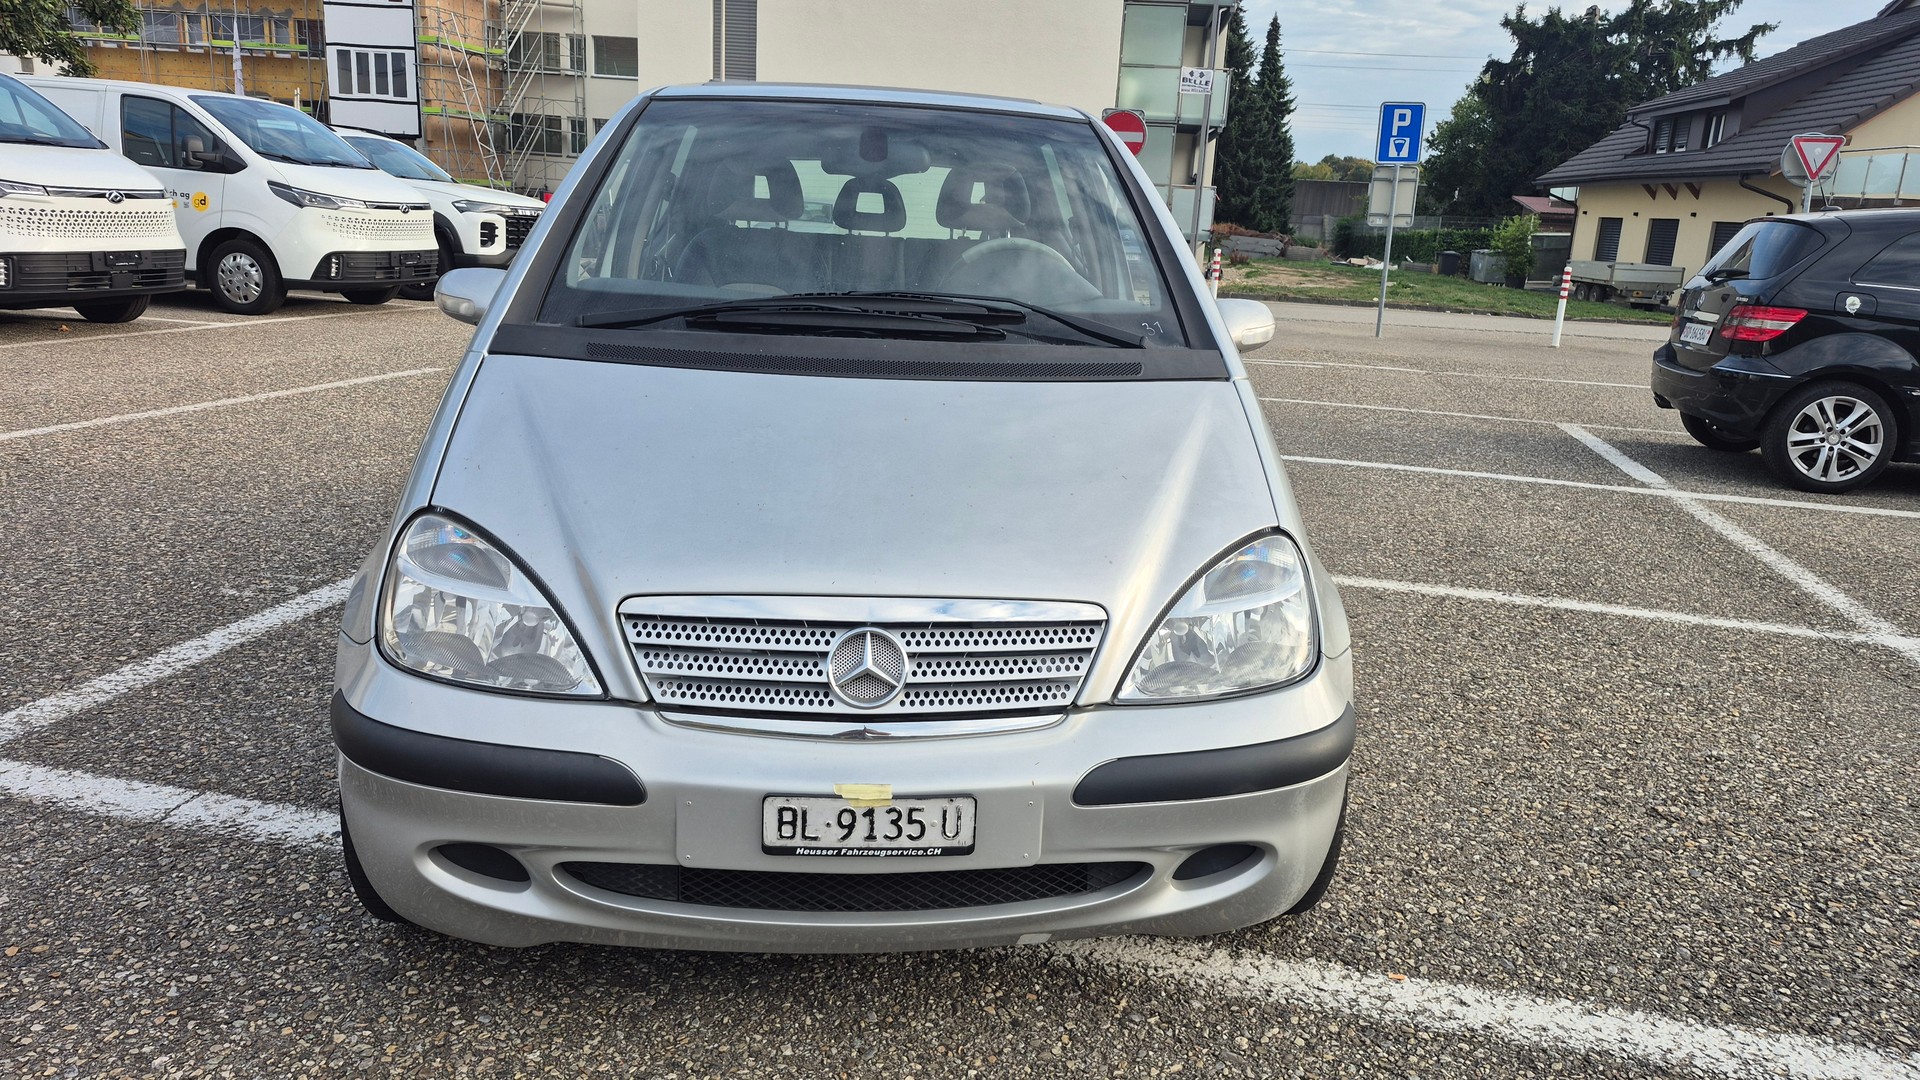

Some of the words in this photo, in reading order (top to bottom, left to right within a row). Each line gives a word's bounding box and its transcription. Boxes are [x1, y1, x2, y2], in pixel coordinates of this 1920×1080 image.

[1182, 77, 1210, 86] BELLE
[1392, 108, 1412, 136] P
[180, 192, 190, 200] ag
[796, 847, 837, 856] Heusser
[840, 847, 942, 858] Fahrzeugservice.CH
